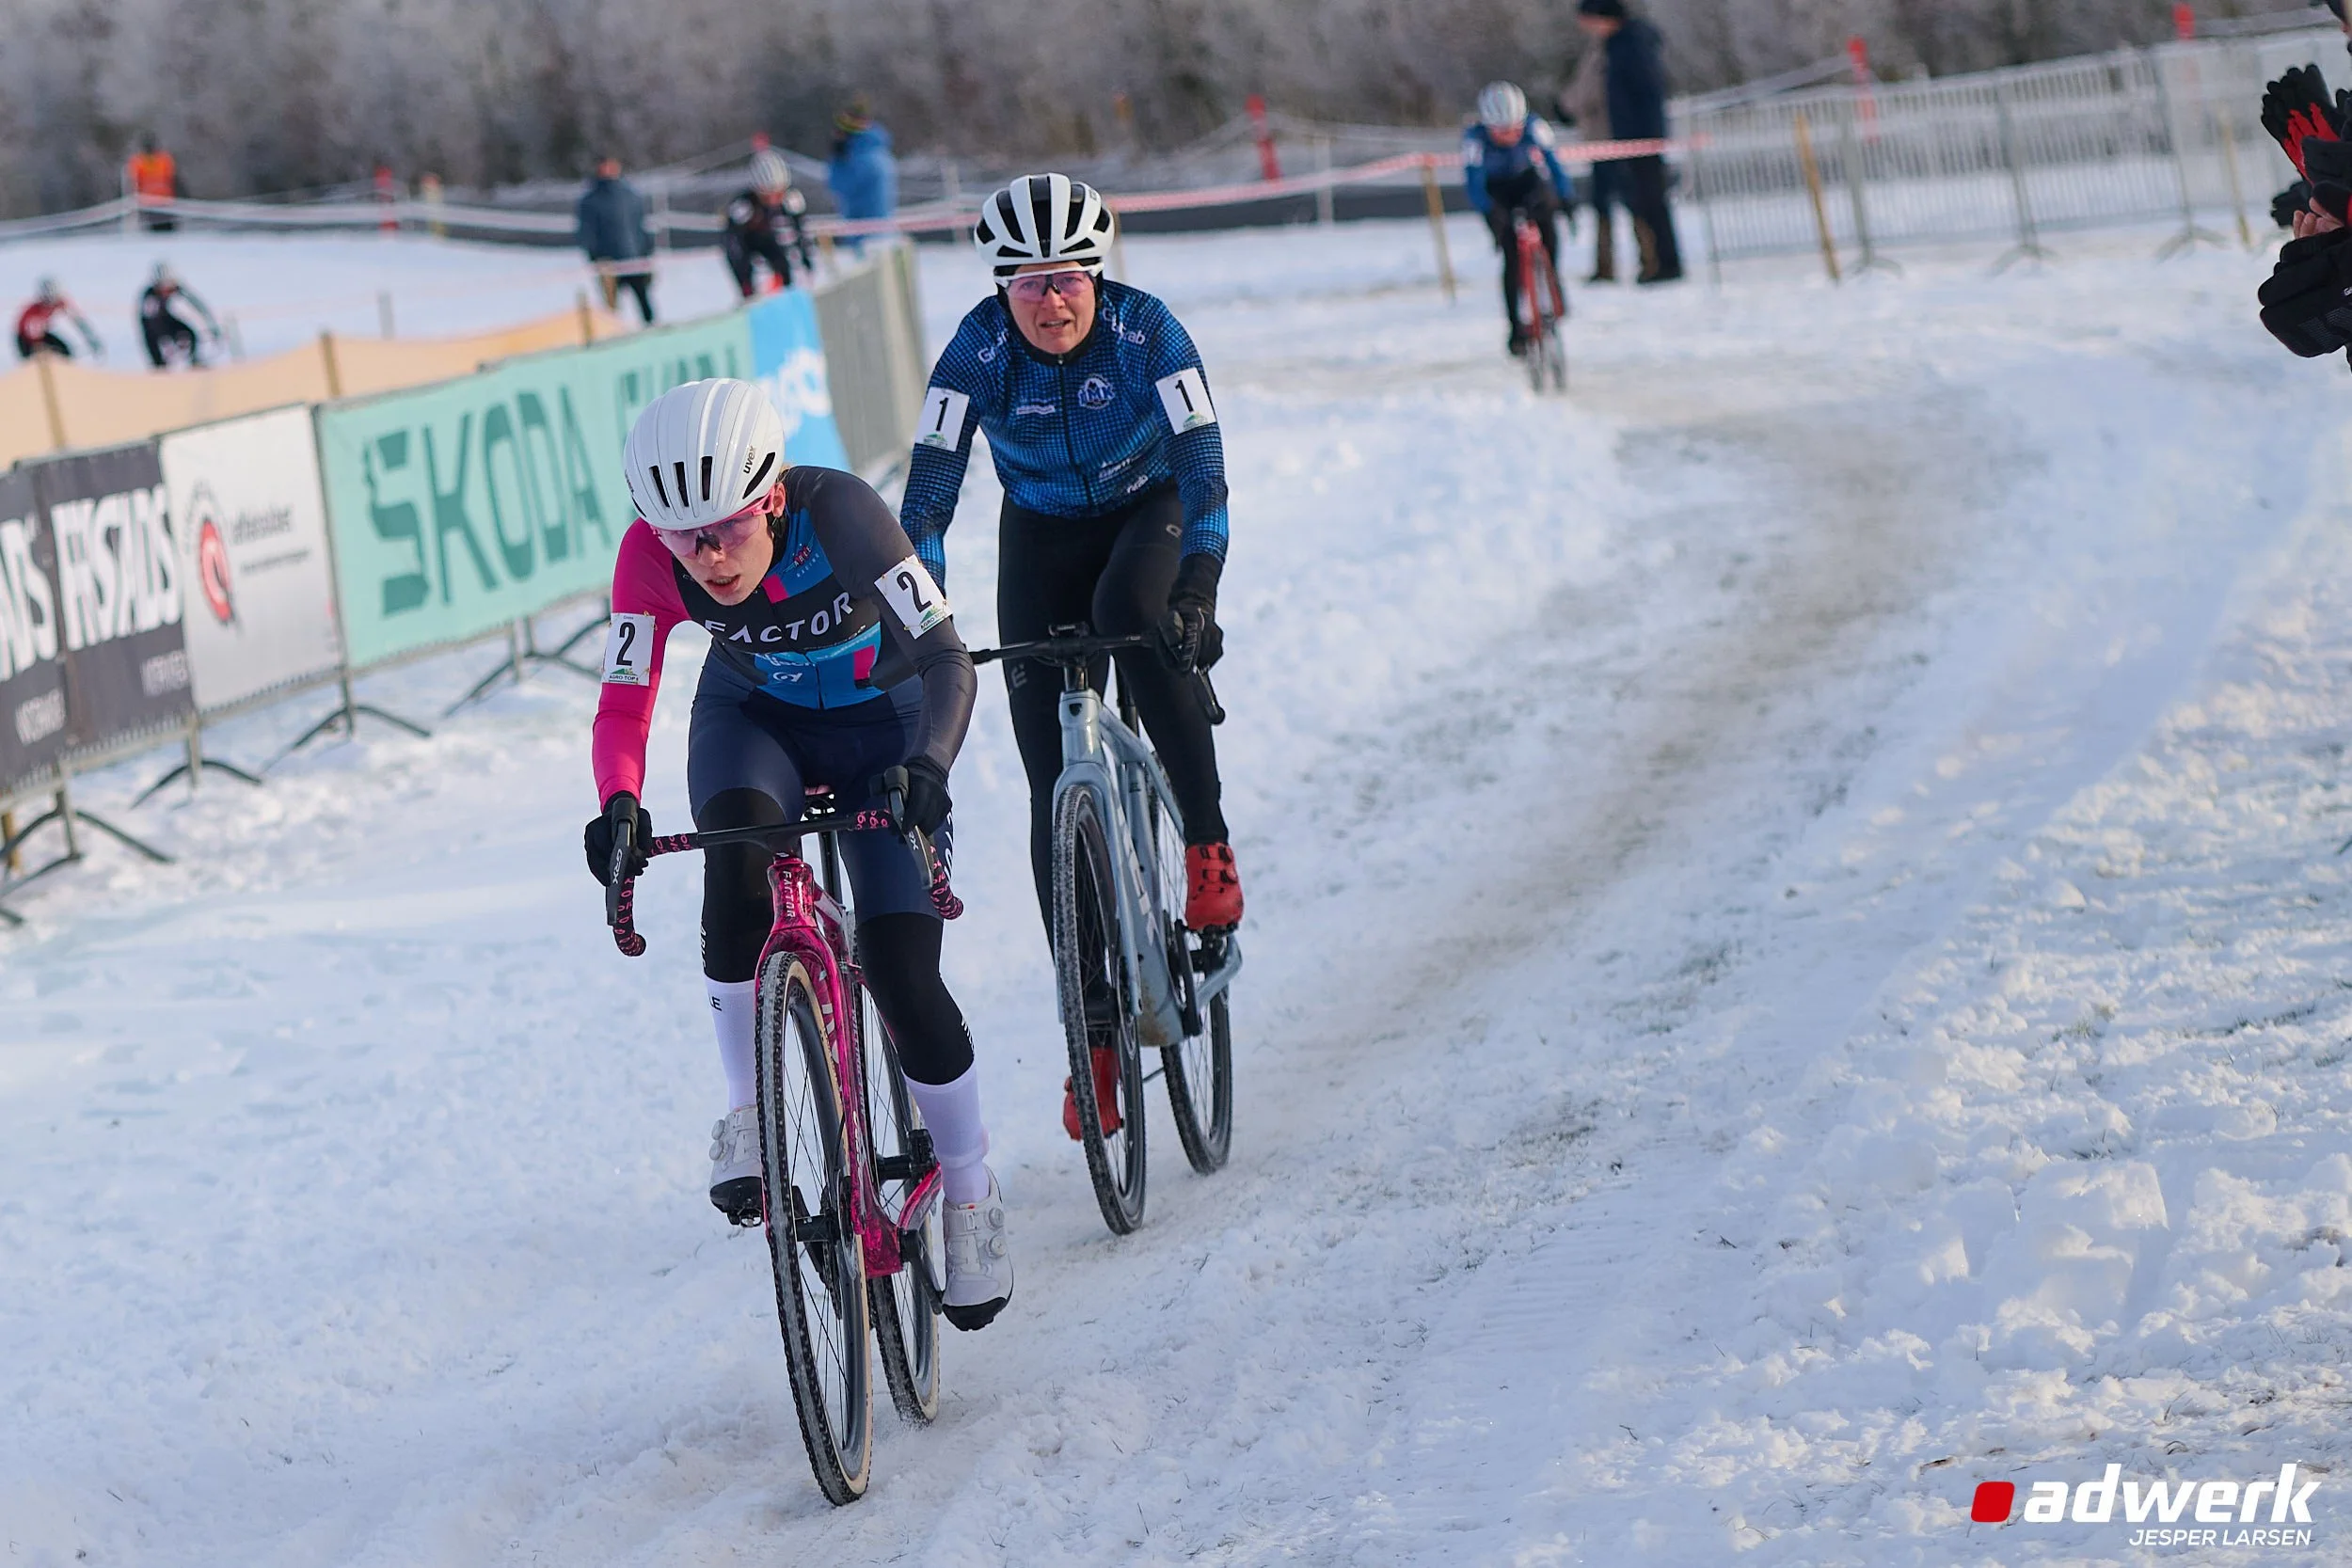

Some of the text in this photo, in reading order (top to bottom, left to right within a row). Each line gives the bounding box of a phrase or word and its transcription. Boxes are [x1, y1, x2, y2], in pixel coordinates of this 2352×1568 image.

[1175, 379, 1194, 413] 1
[935, 397, 949, 432] 1
[742, 445, 757, 474] uvex
[897, 571, 933, 613] 2
[704, 592, 853, 643] FACTOR
[615, 622, 636, 667] 2
[908, 830, 919, 851] RX
[612, 848, 623, 884] GRX
[783, 870, 796, 918] FACTOR
